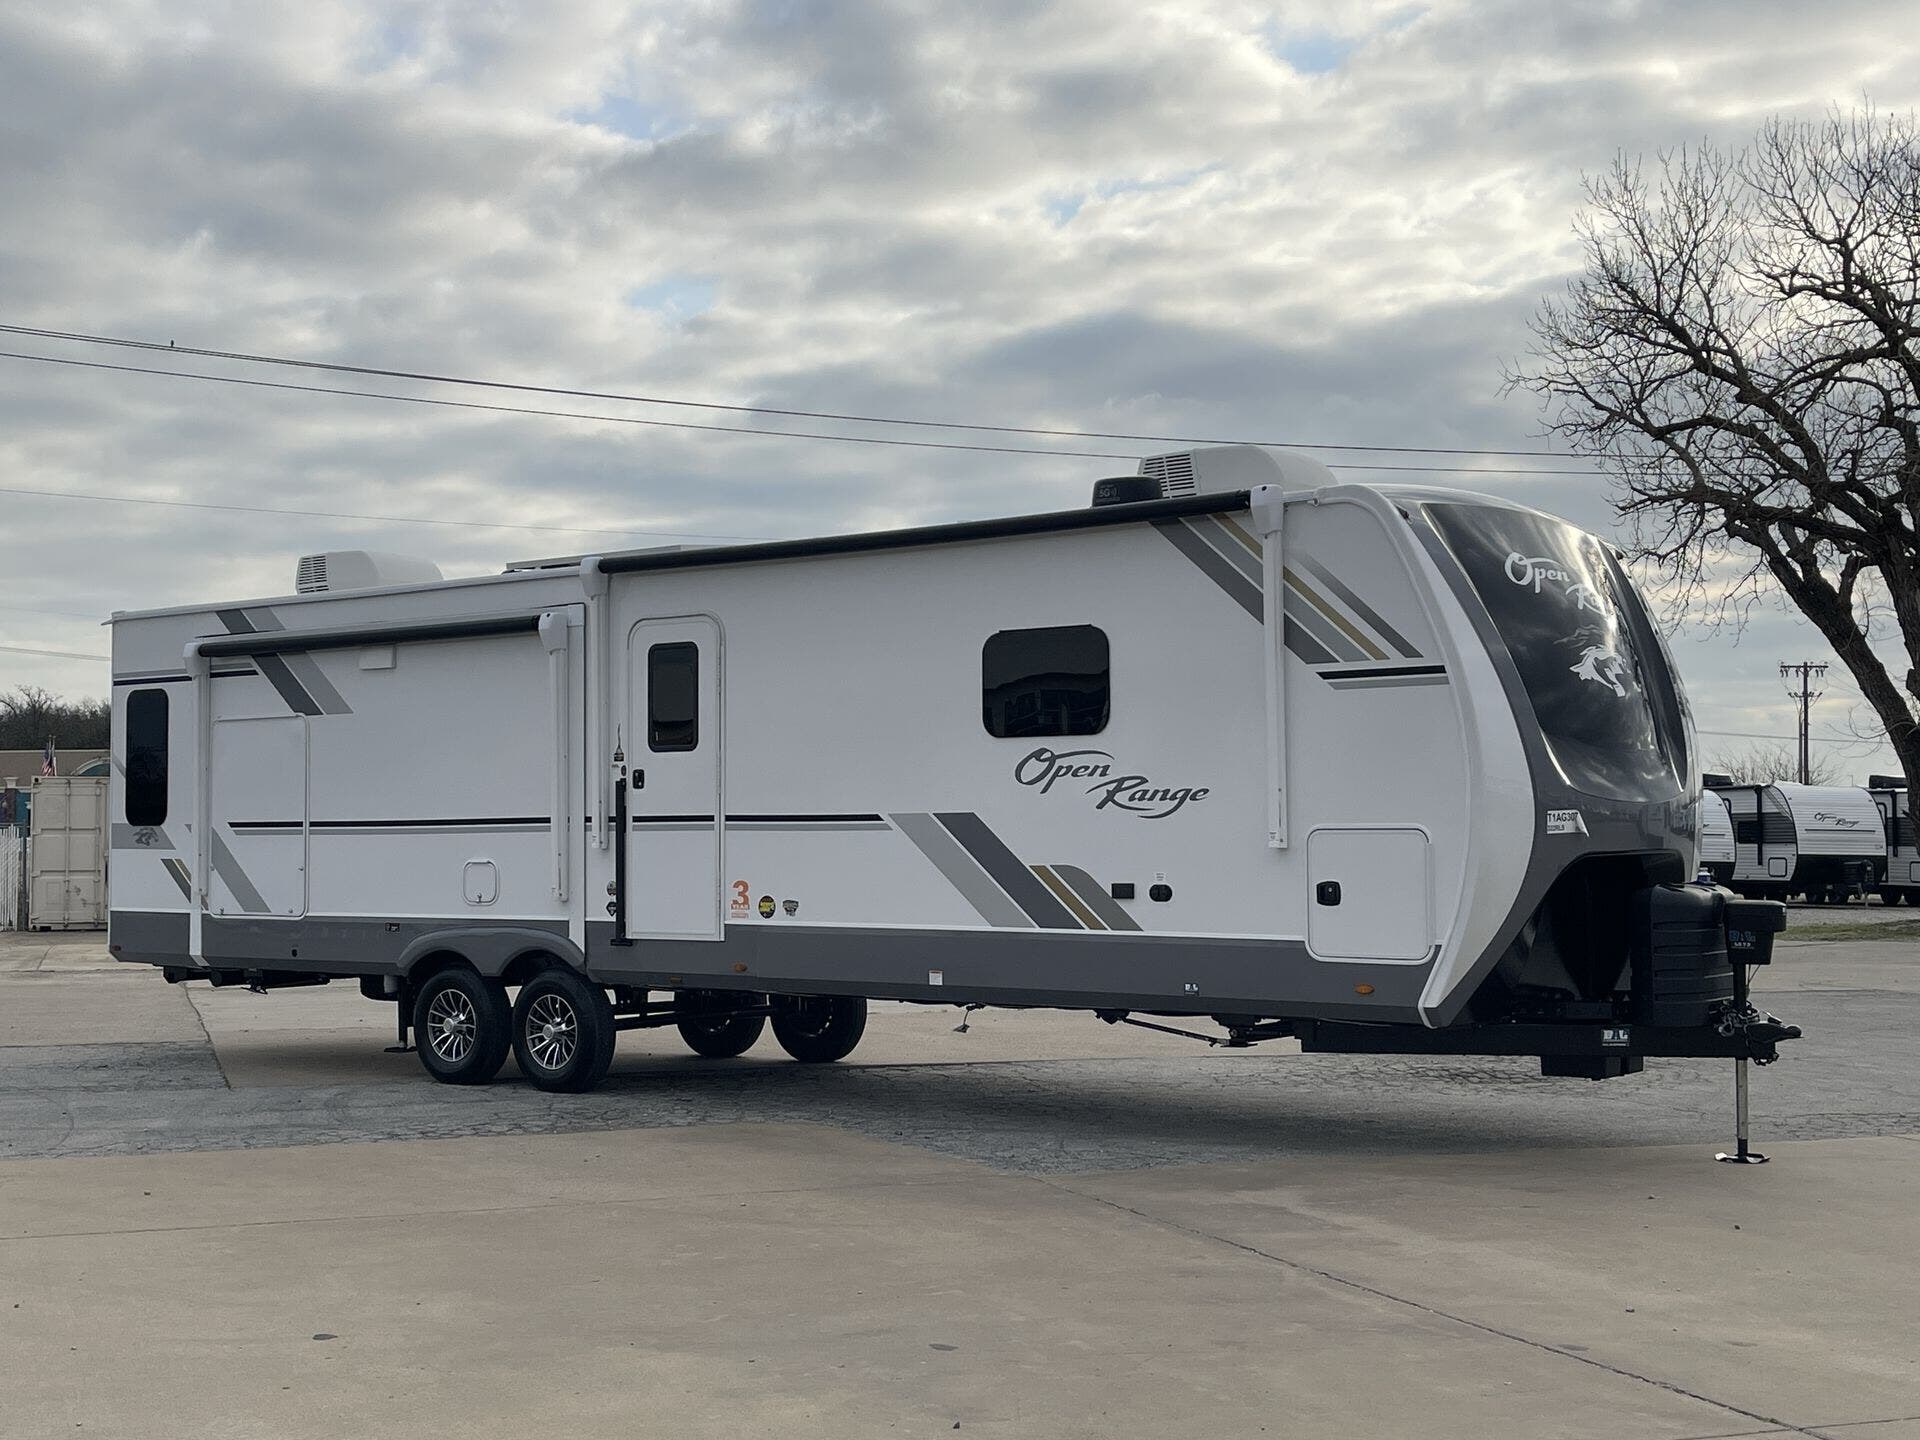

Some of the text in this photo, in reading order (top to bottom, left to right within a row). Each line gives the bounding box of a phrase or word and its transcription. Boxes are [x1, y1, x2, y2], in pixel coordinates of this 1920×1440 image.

[1505, 552, 1570, 593] Open
[1014, 747, 1210, 819] Open Range
[733, 880, 749, 905] 3
